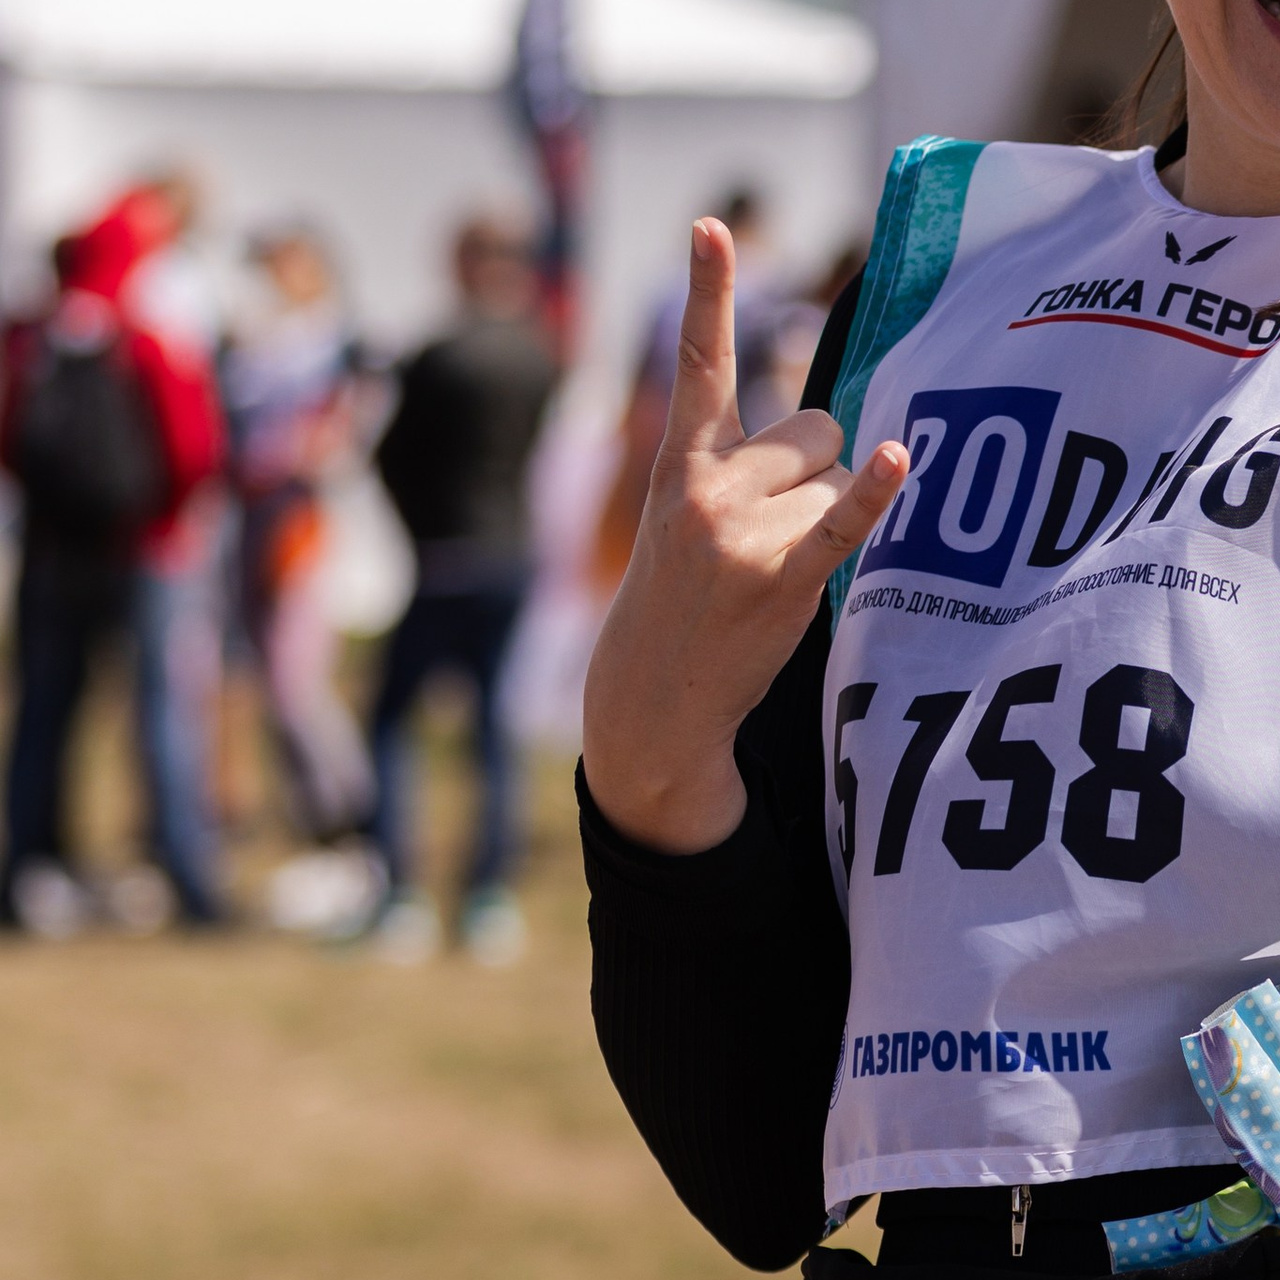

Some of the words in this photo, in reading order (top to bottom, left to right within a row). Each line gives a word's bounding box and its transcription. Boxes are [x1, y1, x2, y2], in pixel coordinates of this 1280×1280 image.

[1022, 277, 1145, 318] ГОНКА
[905, 590, 945, 618] ДЛЯ
[1051, 562, 1159, 605] БЛАГОСОСТОЯНИЕ
[1157, 564, 1199, 593] ДЛЯ
[1198, 572, 1242, 606] ВСЕХ
[832, 662, 1196, 892] 5158
[851, 1029, 1113, 1080] ГАЗПРОМБАНК
